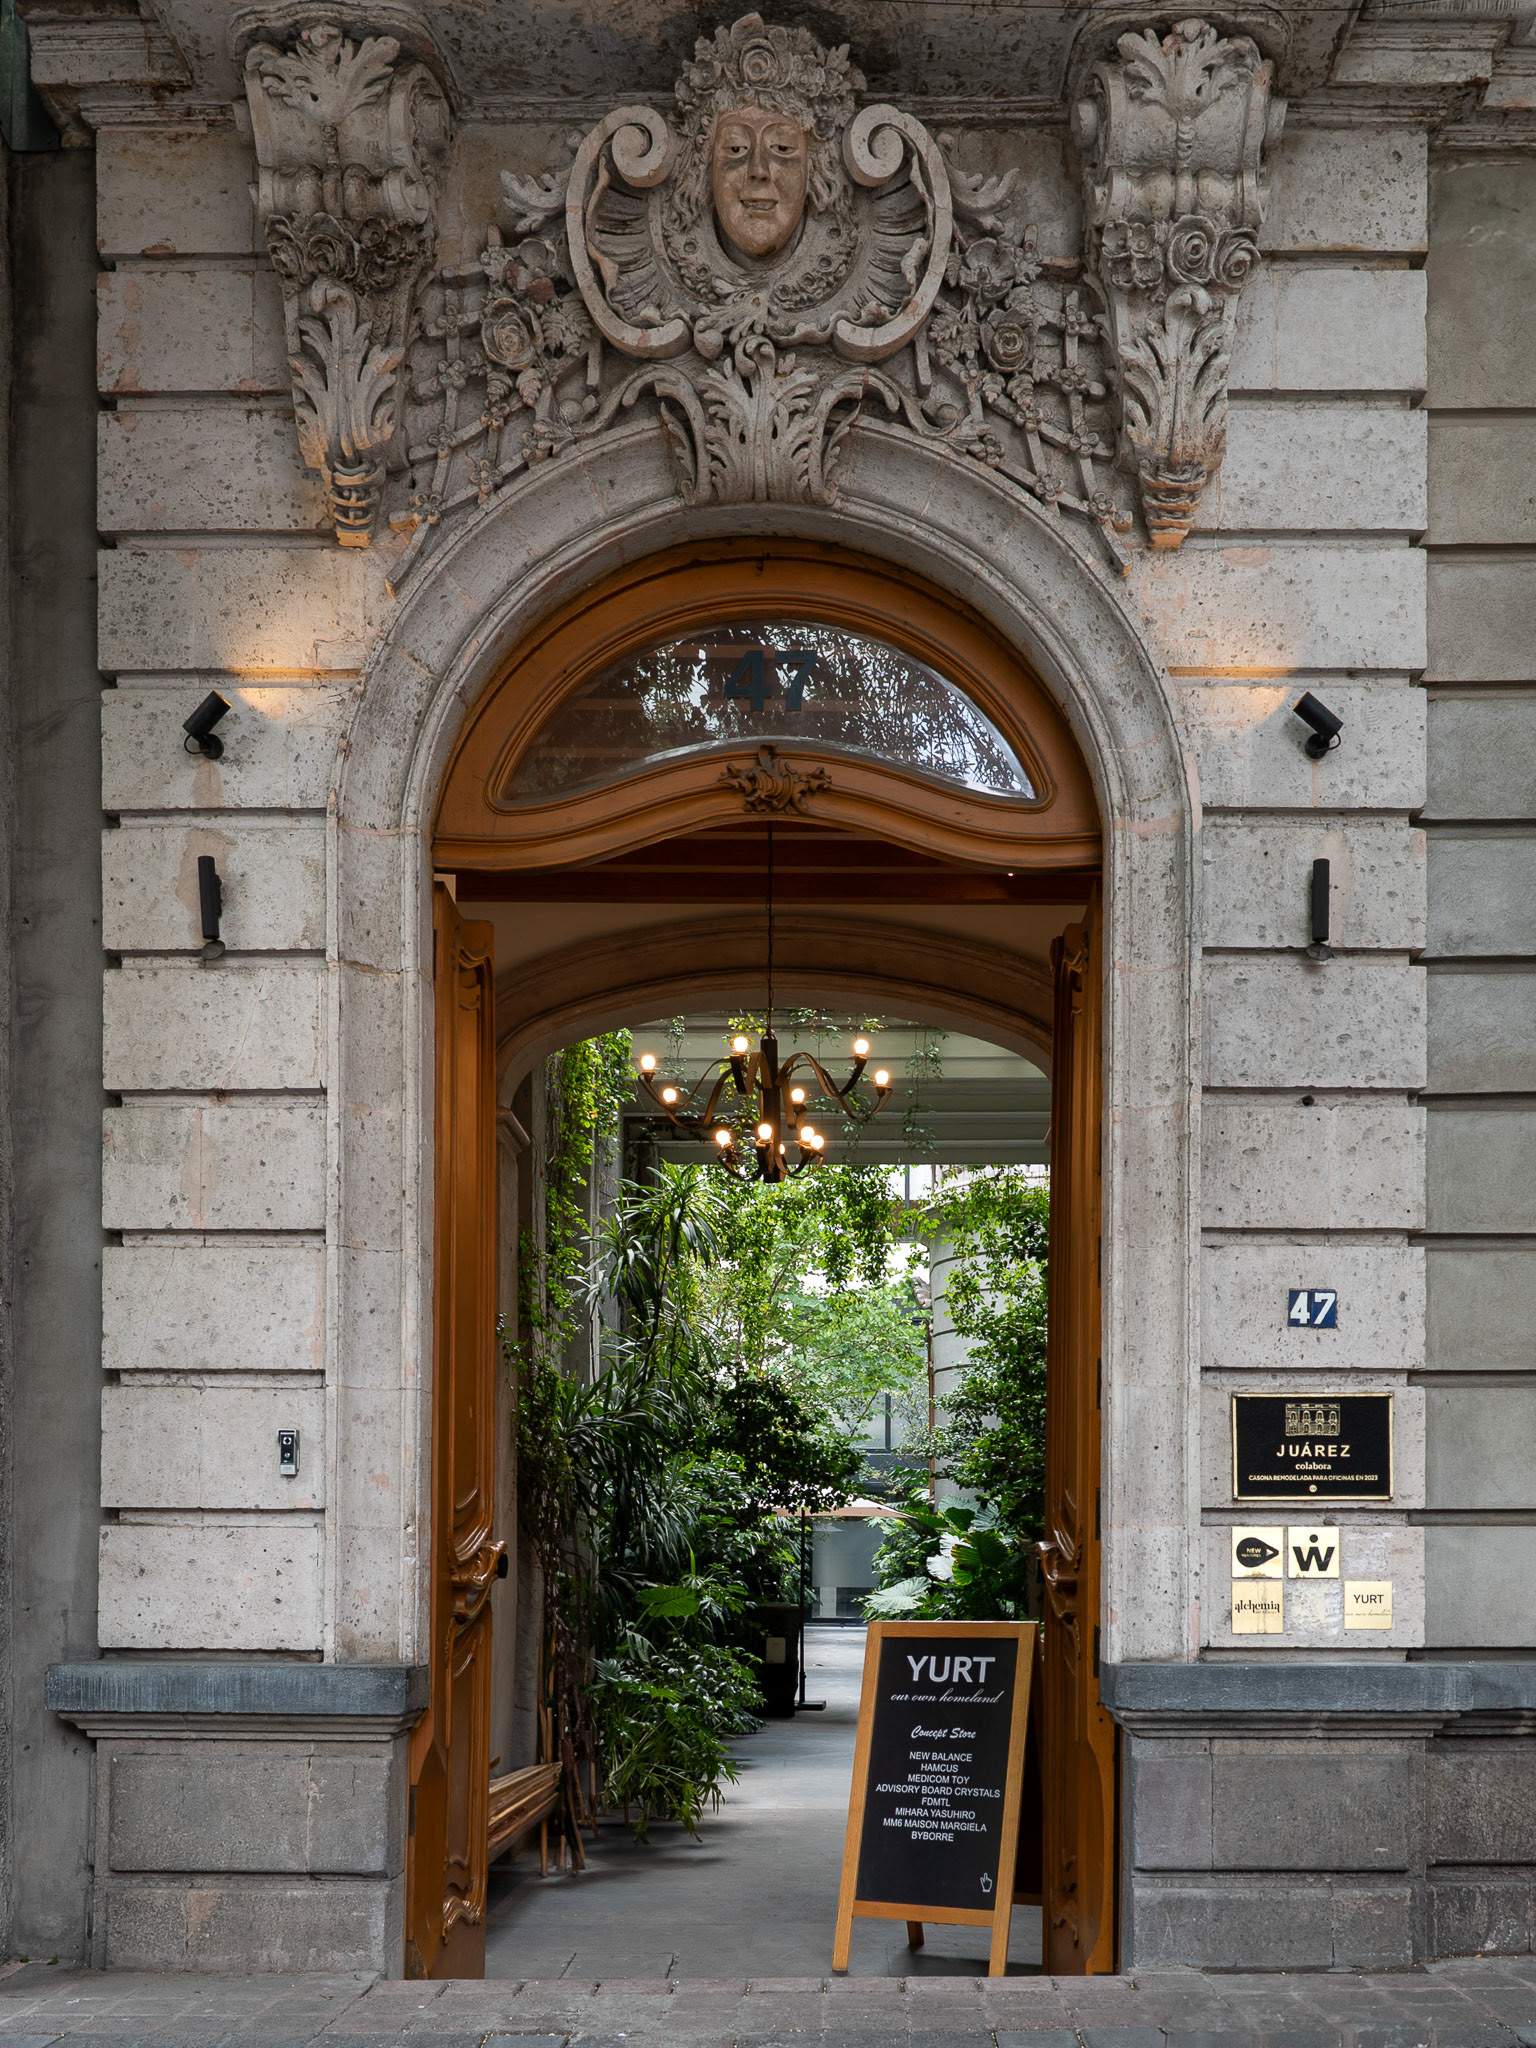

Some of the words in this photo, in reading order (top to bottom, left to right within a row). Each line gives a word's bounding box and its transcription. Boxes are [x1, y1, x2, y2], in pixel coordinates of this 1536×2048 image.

[724, 650, 817, 711] 47
[1290, 1291, 1336, 1325] 47
[1276, 1441, 1351, 1457] JUÁREZ
[1295, 1462, 1332, 1470] colabora
[1234, 1599, 1280, 1614] alchemia
[1353, 1594, 1384, 1604] YURT
[906, 1655, 996, 1683] YURT
[890, 1693, 910, 1701] our
[911, 1694, 937, 1702] own
[938, 1687, 1005, 1704] homeland
[911, 1725, 948, 1740] Concept
[949, 1727, 977, 1739] Store
[909, 1751, 930, 1760] NEW
[931, 1752, 973, 1762] BALANCE
[920, 1763, 959, 1773] HAMCUS
[907, 1774, 950, 1784] MEDICOM
[951, 1775, 970, 1785] TOY
[875, 1783, 920, 1794] ADVISORY
[921, 1786, 953, 1796] BOARD
[954, 1787, 1001, 1799] CRYSTALS
[921, 1797, 951, 1807] FDMTL
[895, 1807, 929, 1817] MIHARA
[930, 1809, 976, 1820] YASUHIRO
[883, 1818, 903, 1828] MM6
[904, 1819, 939, 1830] MAISON
[940, 1821, 987, 1833] MARGIELA
[911, 1831, 955, 1842] BYBORRE
